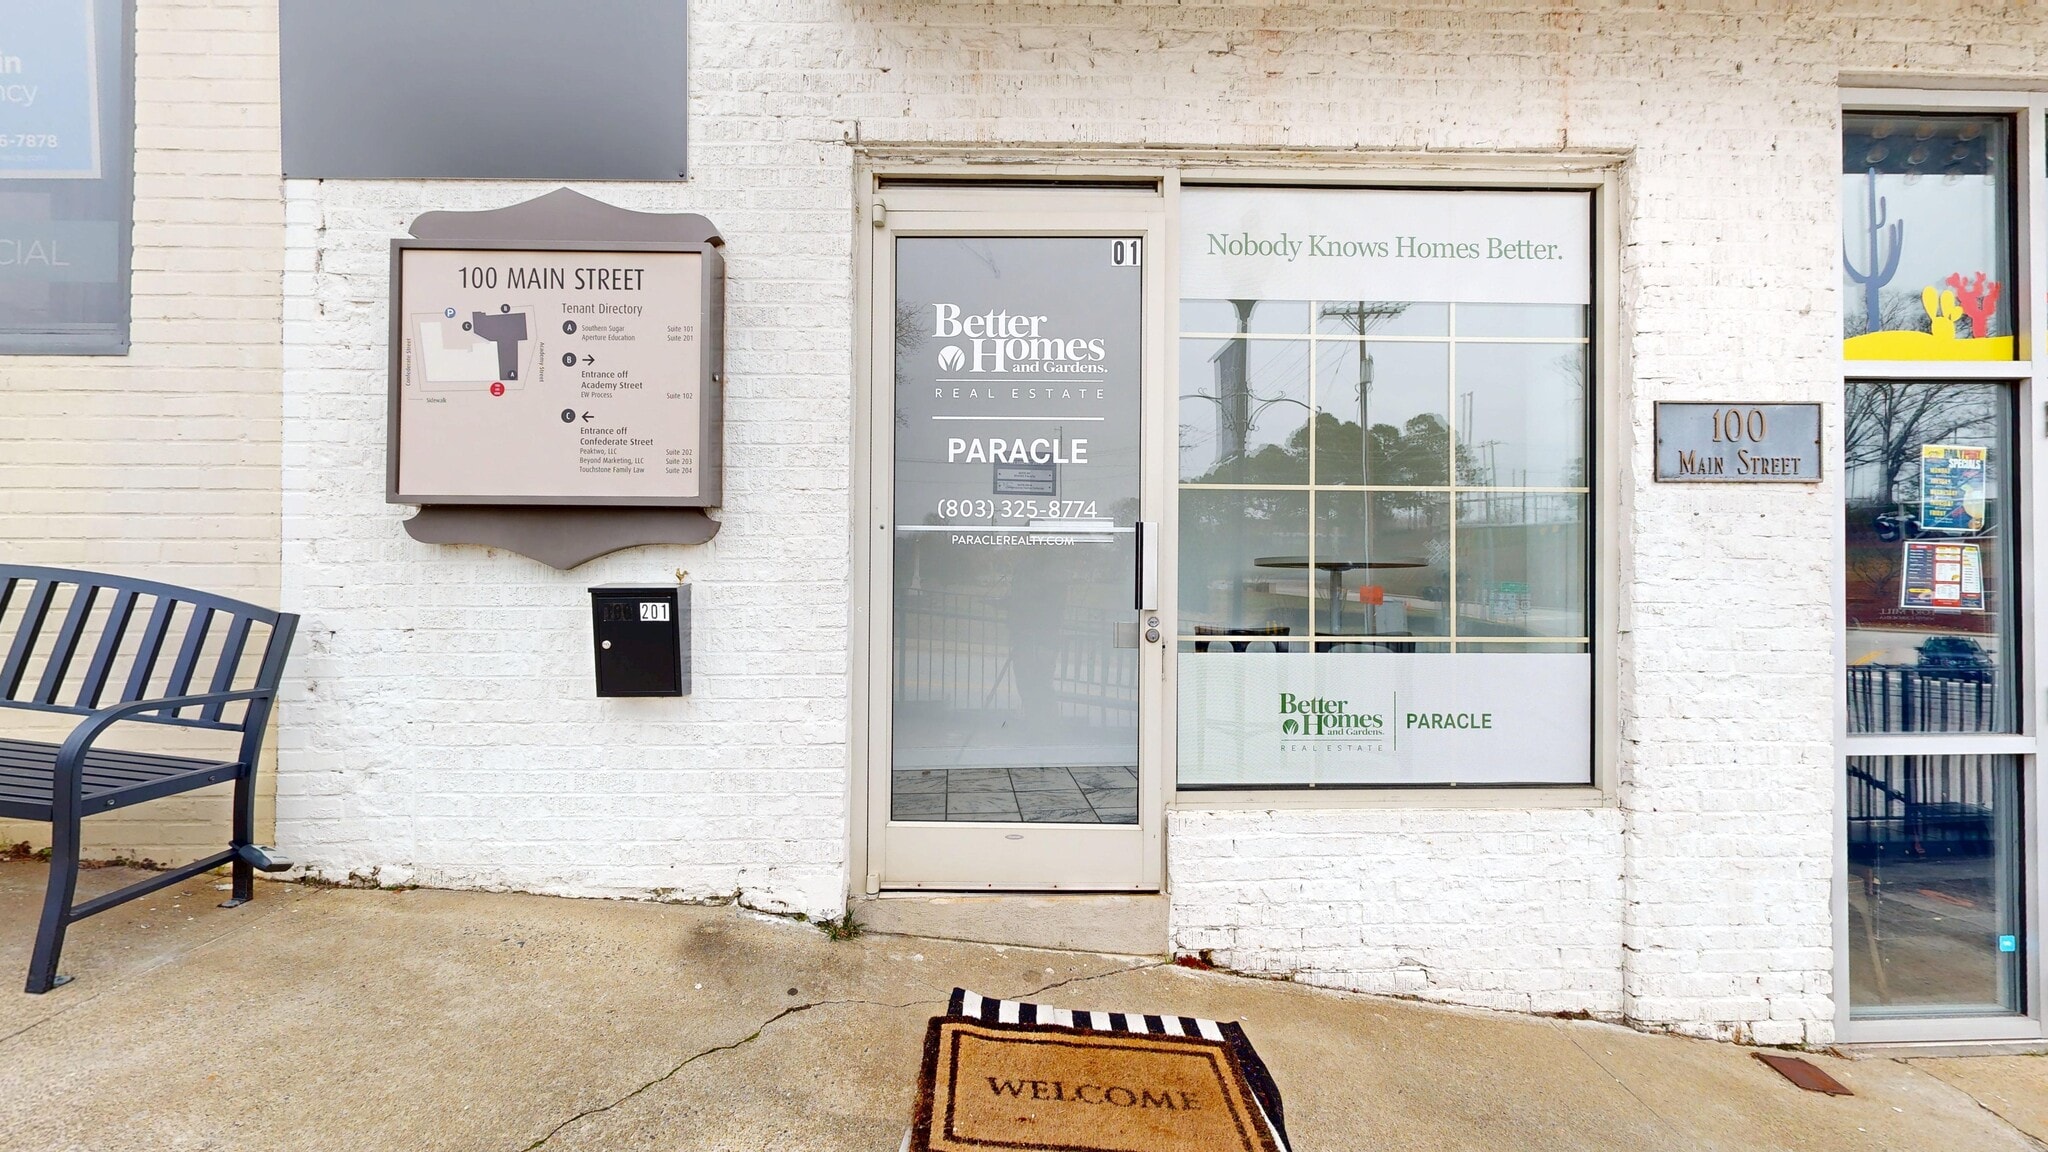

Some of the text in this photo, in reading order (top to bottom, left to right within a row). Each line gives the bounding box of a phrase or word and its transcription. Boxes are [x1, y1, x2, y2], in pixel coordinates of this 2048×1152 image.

[1113, 241, 1138, 265] 01
[1207, 232, 1562, 262] Nobody Knows Homes Better.
[459, 267, 644, 290] 100 MAIN STREET
[447, 309, 454, 317] P
[562, 303, 642, 317] Tenant Directory
[932, 303, 1047, 338] Better
[609, 325, 624, 333] Sugar
[969, 338, 1105, 373] Homes
[1012, 362, 1040, 373] and
[581, 381, 617, 390] Academy
[936, 389, 1103, 398] REAL ESTATE
[1712, 408, 1767, 442] 100
[580, 437, 627, 445] Confederate
[949, 438, 1087, 463] PARACLE
[603, 457, 633, 465] Marketing,
[1949, 459, 1981, 469] SPECIALS
[613, 466, 631, 474] Family
[937, 498, 1098, 519] (803) 325-8774
[952, 534, 1074, 546] PARACLEREALTY.COM
[642, 604, 667, 619] 201
[1278, 692, 1348, 715] Better
[1301, 712, 1384, 735] Homes
[1407, 713, 1492, 729] PARACLE
[1327, 728, 1344, 736] and
[1280, 744, 1384, 752] REAL ESTATE
[987, 1076, 1202, 1111] WELCOME
